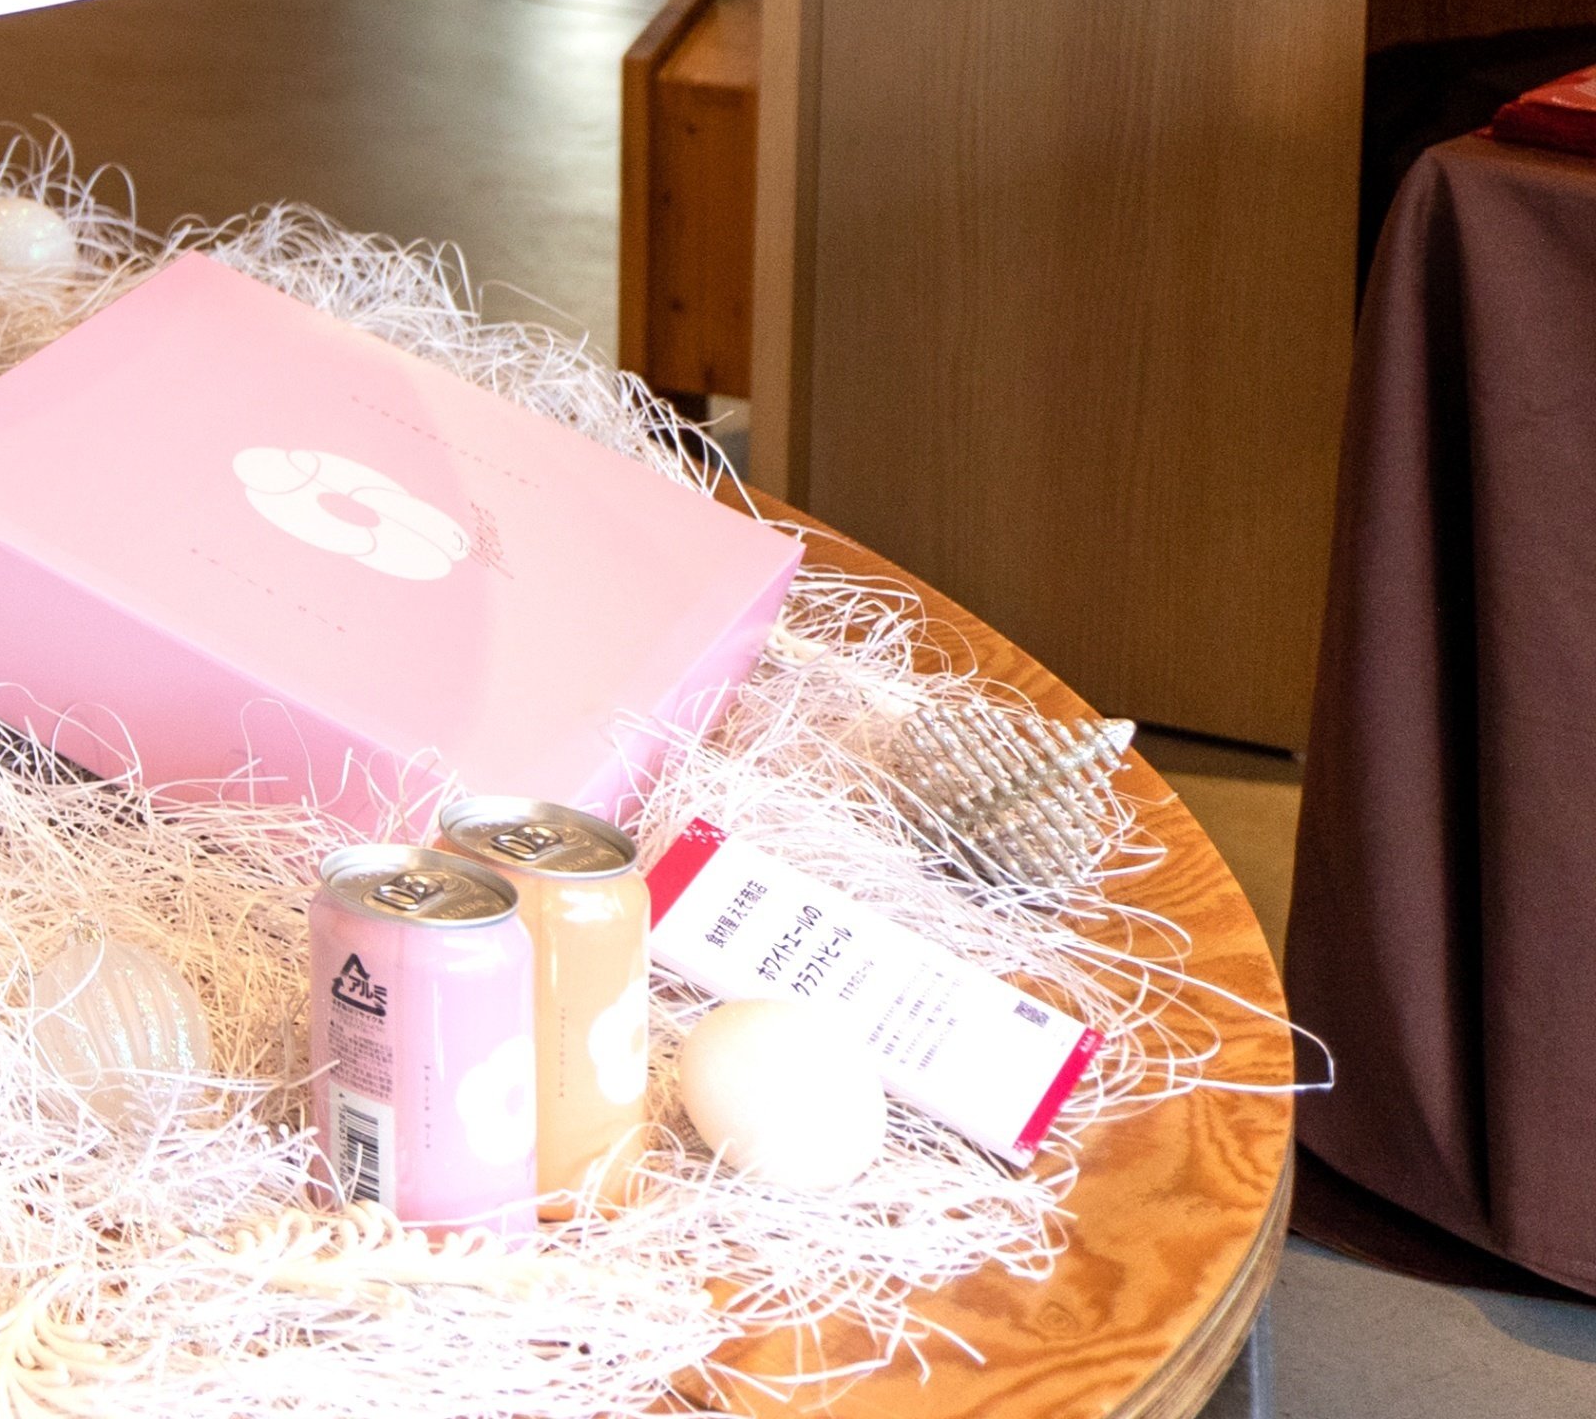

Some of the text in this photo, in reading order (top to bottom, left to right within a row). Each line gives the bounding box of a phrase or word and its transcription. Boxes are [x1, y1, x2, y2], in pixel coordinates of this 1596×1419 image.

[704, 878, 769, 949] 食材屋 えぞ商店
[755, 903, 823, 982] ホワイトエールの
[348, 975, 387, 1005] アルミ
[791, 925, 853, 997] クラフトビール
